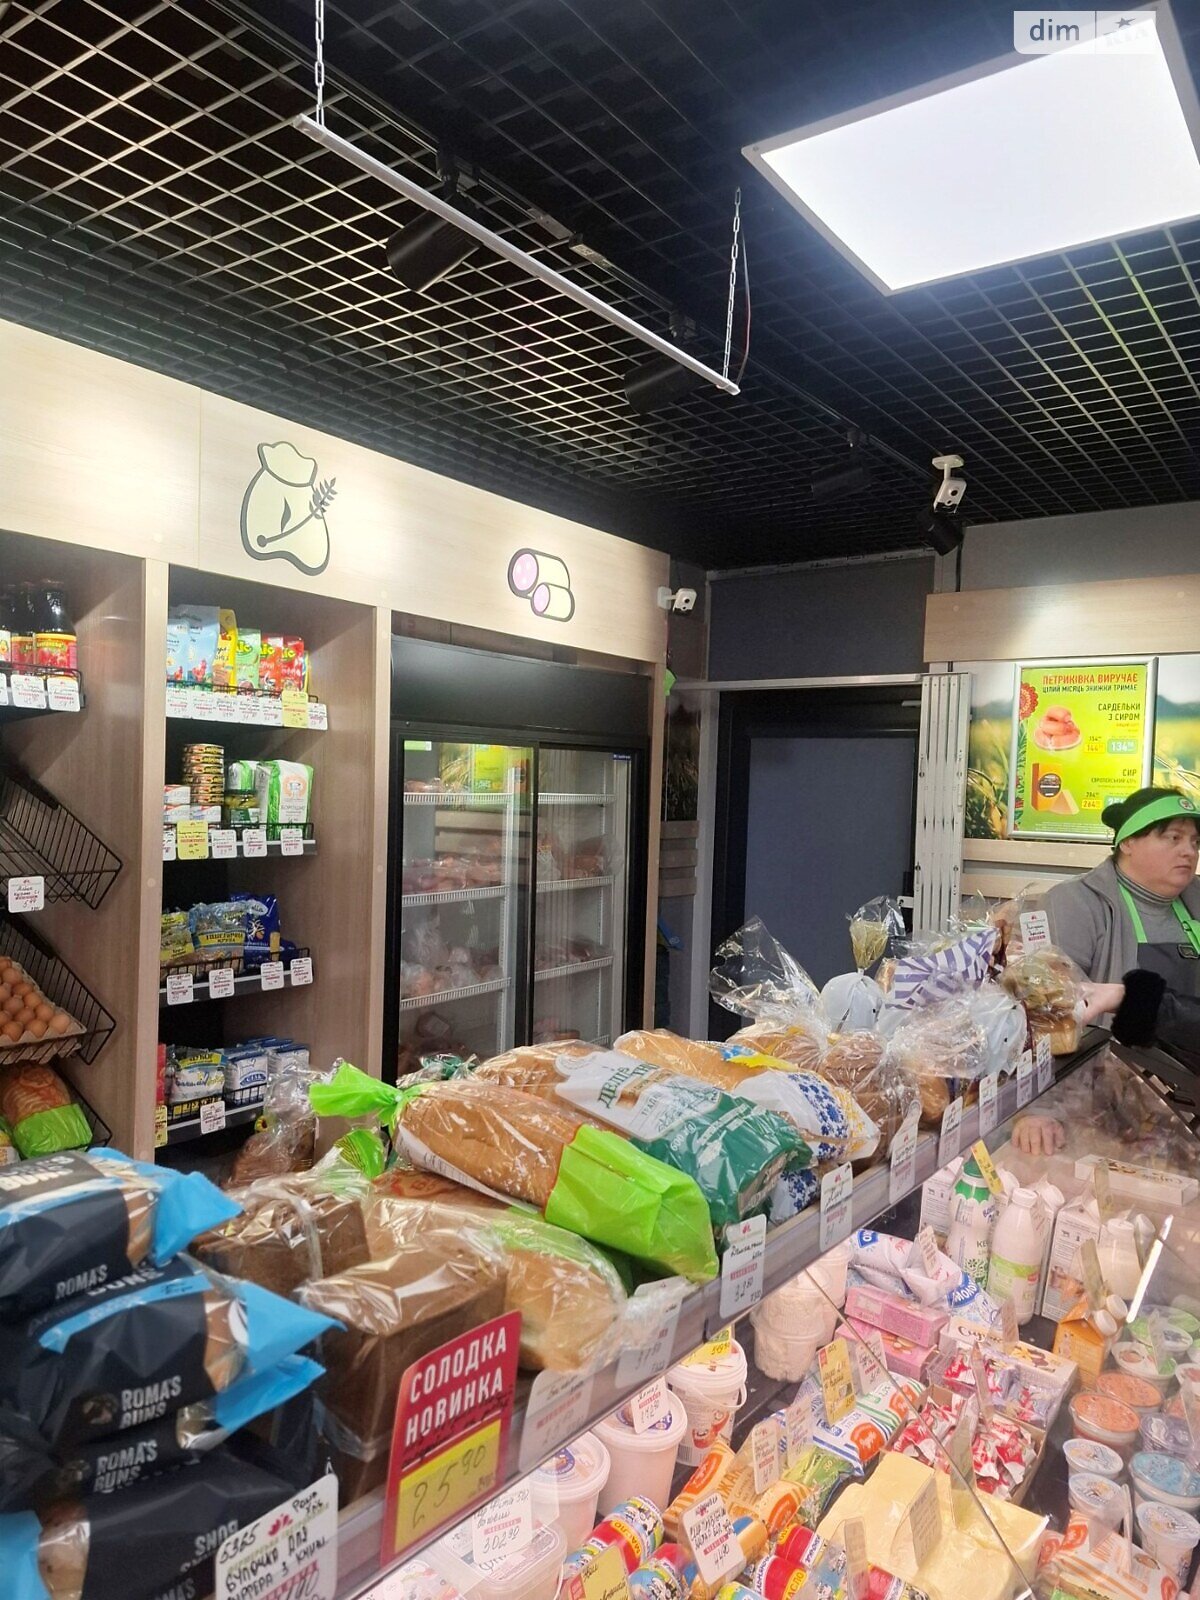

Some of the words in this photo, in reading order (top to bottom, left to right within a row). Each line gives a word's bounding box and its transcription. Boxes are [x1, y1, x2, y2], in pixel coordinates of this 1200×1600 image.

[1042, 674, 1095, 685] ПЕТРИКІВКА
[1097, 672, 1138, 684] ВИРУЧАЄ
[1097, 703, 1141, 711] САРДЕЛЬКИ
[1122, 768, 1137, 777] СИР
[408, 1326, 508, 1405] СОЛОДКА
[404, 1366, 504, 1448] НОВИНКА
